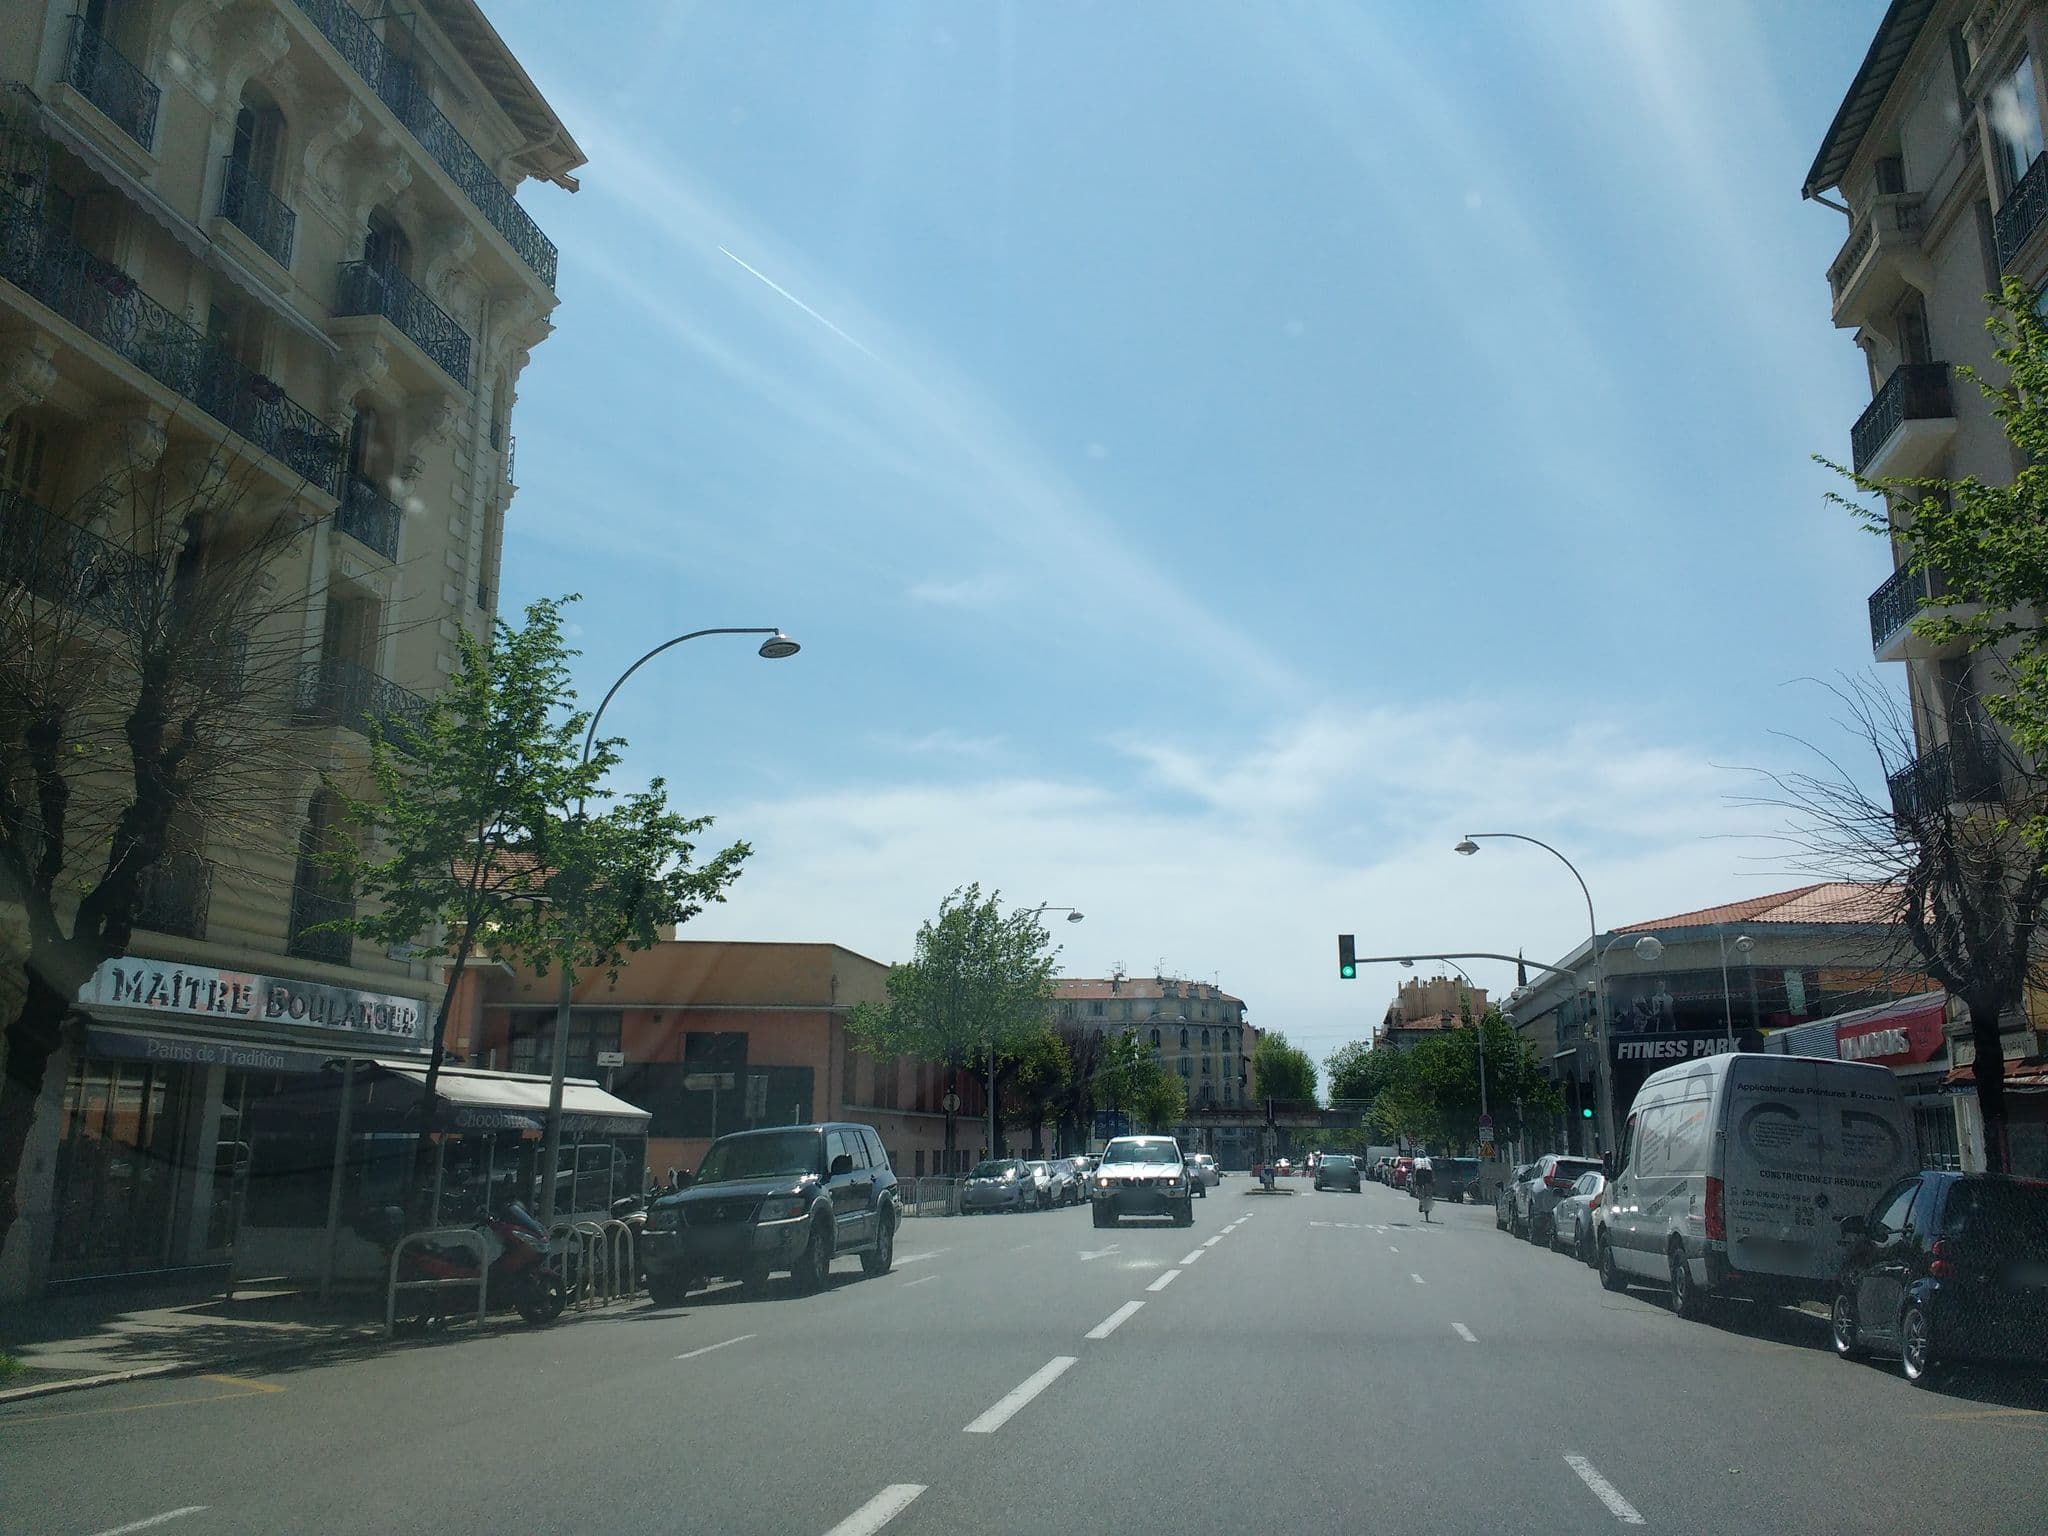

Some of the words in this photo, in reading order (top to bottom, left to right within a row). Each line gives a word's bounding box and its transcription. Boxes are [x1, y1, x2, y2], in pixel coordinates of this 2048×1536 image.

[112, 967, 250, 1015] MAÎTRE
[264, 986, 420, 1036] BOULANGER
[147, 1041, 192, 1060] Pains
[197, 1043, 215, 1062] de
[219, 1045, 285, 1069] Tradition
[1617, 1040, 1688, 1060] FITNESS
[1692, 1037, 1742, 1056] PARK
[1737, 1082, 1786, 1094] Applicateur
[1788, 1087, 1805, 1096] des
[1806, 1087, 1847, 1099] Peintures
[1759, 1169, 1821, 1186] CONSTRUCTION
[1822, 1178, 1832, 1188] ET
[1833, 1178, 1883, 1192] RENOVATION
